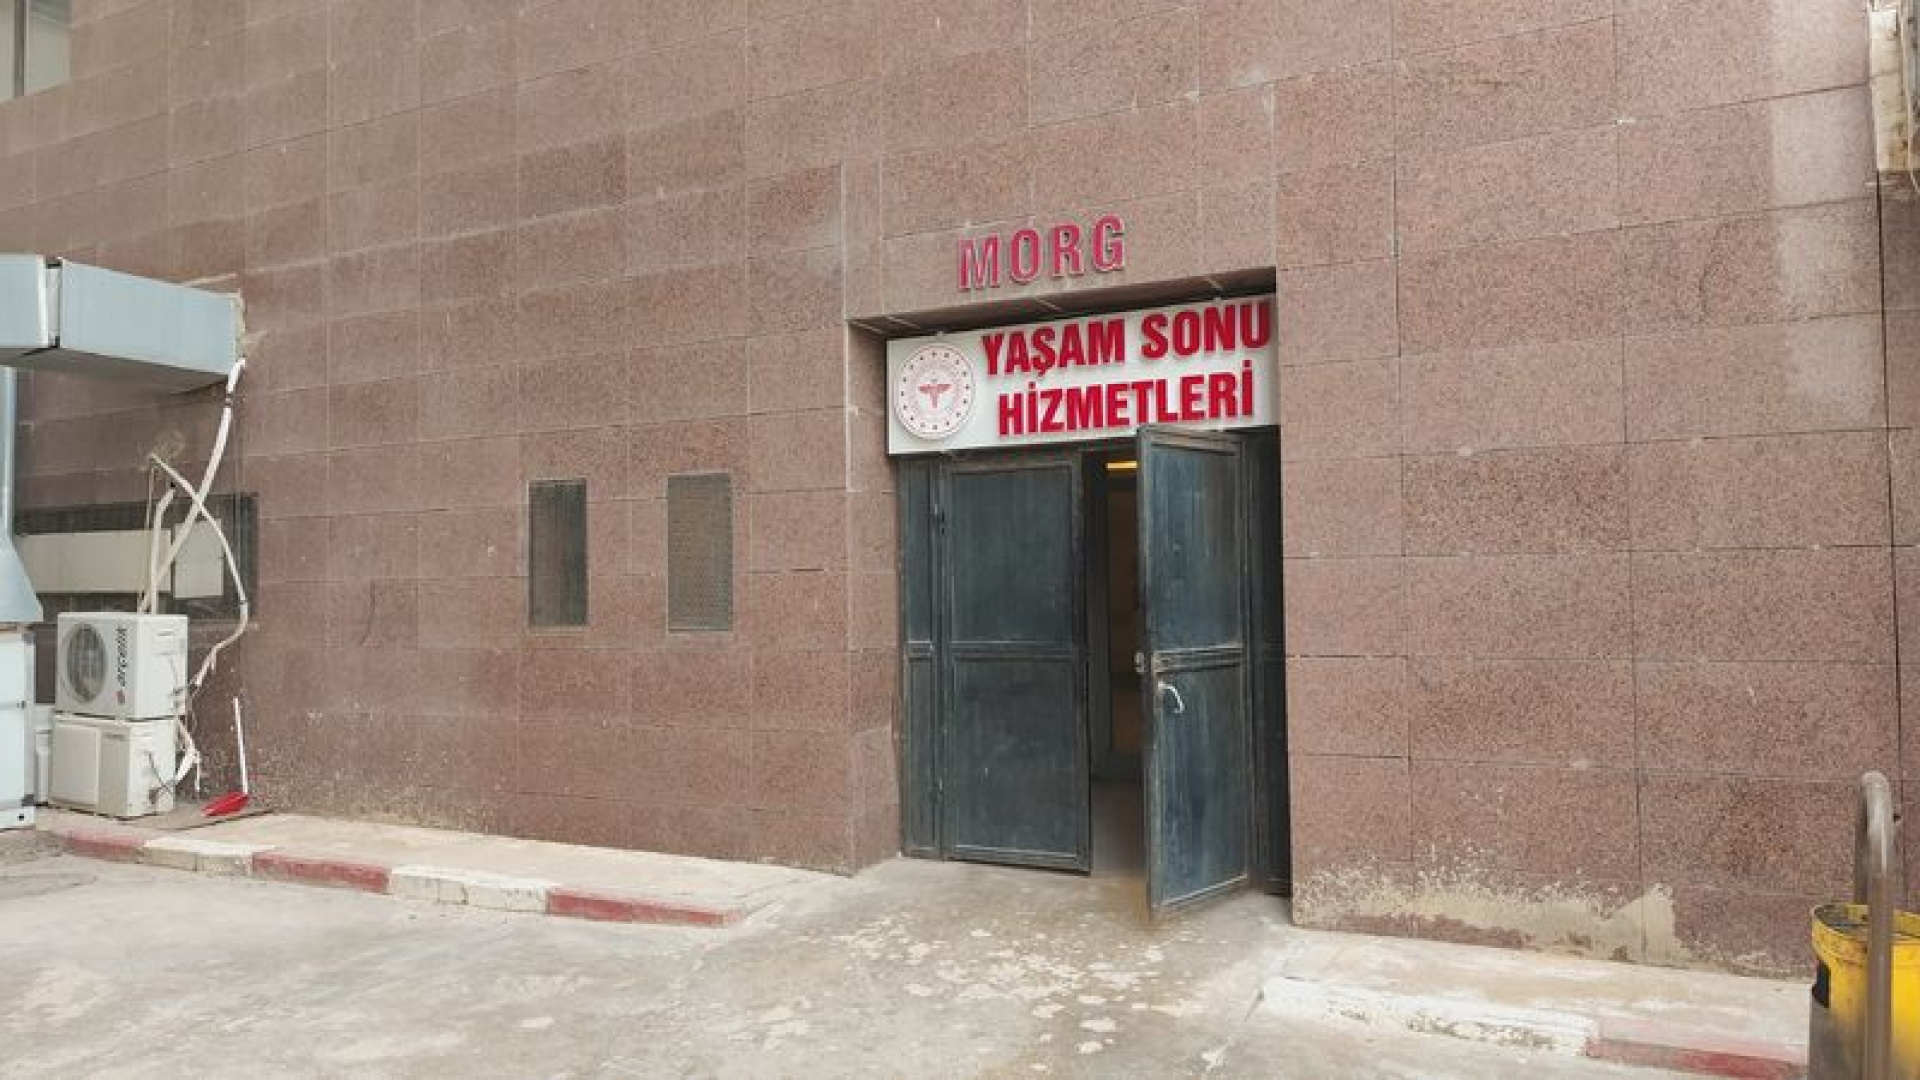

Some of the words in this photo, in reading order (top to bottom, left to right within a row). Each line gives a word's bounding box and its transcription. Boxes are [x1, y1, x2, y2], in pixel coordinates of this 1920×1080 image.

[958, 214, 1126, 290] MORG
[981, 318, 1126, 377] YAŞAM
[1140, 301, 1272, 361] SONU
[997, 359, 1255, 437] HİZMETLERİ
